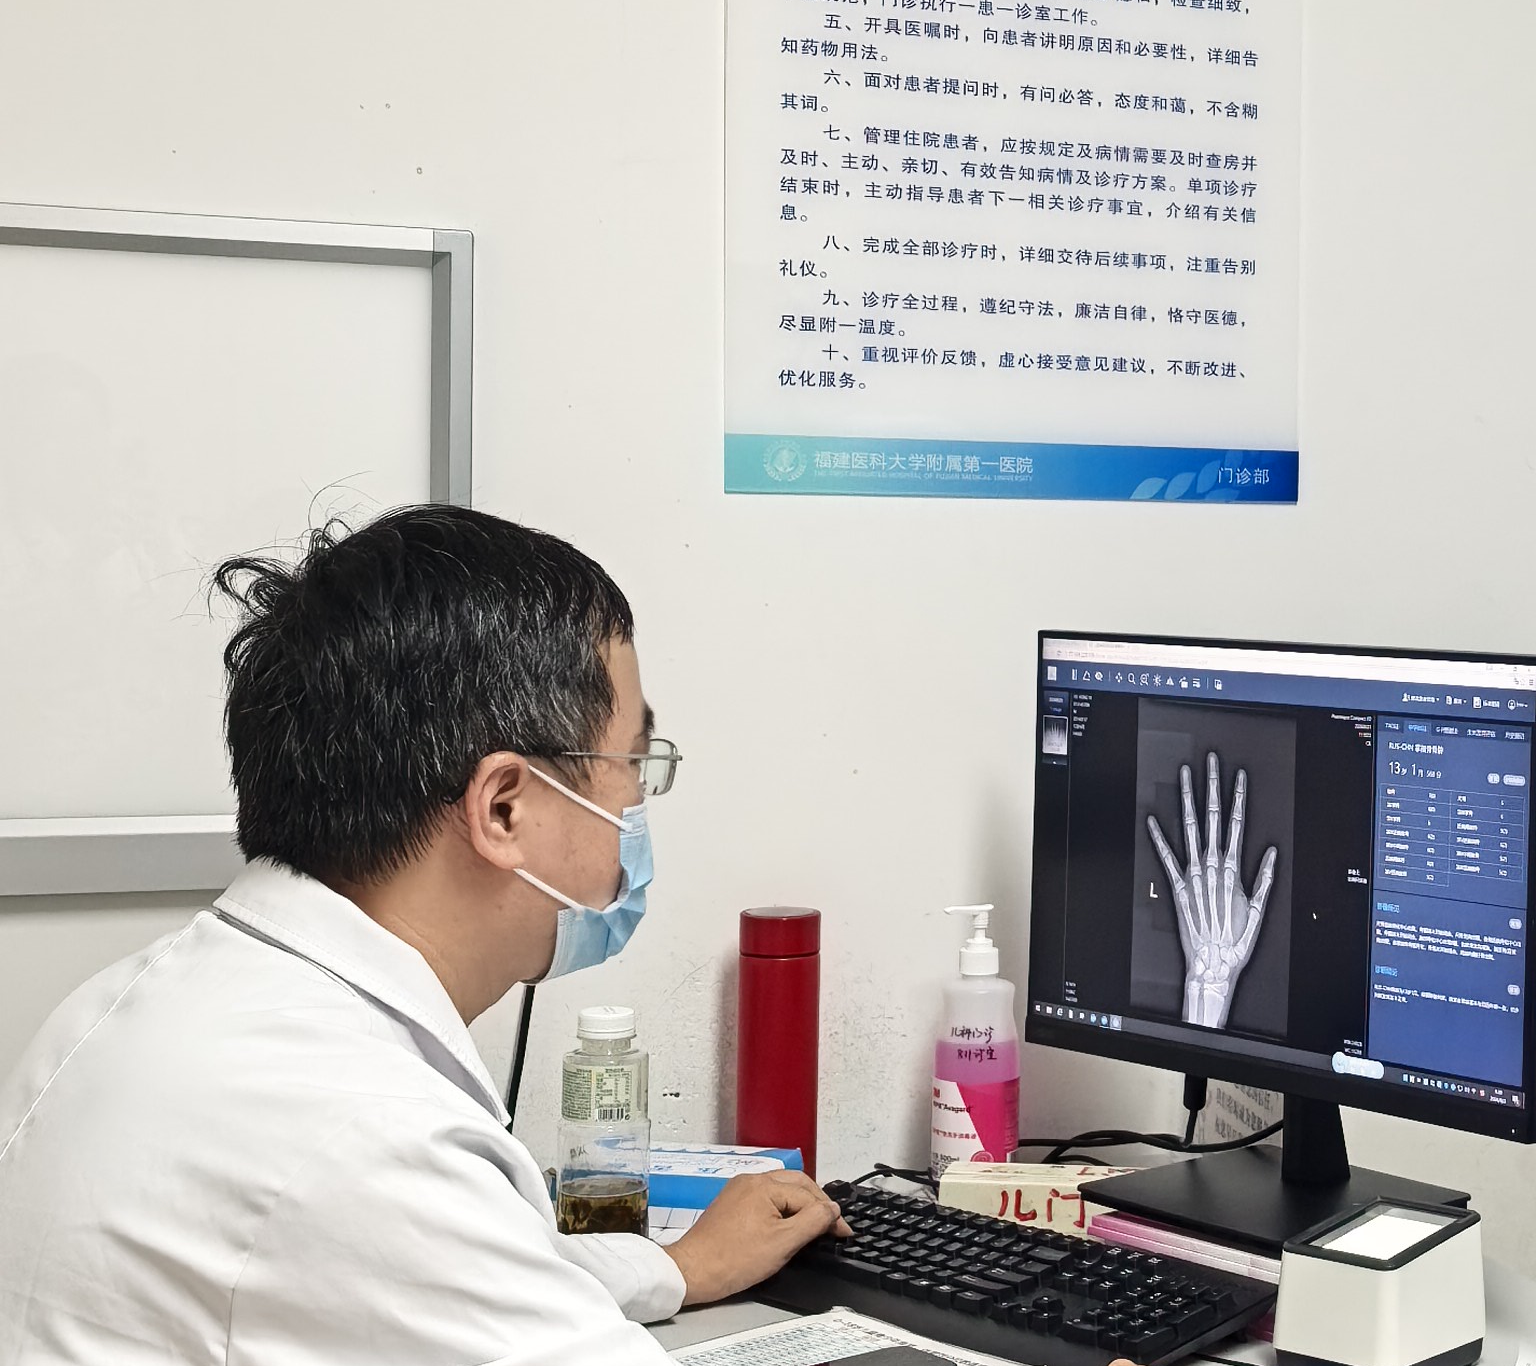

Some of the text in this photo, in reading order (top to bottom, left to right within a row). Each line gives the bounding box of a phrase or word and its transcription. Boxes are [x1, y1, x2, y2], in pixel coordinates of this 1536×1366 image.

[781, 36, 888, 62] 知药物用法。
[780, 92, 829, 113] 其词。
[780, 203, 808, 223] 息。
[778, 259, 828, 279] 礼仪。
[778, 314, 906, 337] 尽显附一温度。
[778, 369, 867, 390] 优化服务。
[814, 450, 1034, 474] 福建医科大学附属第一医院
[1217, 466, 1270, 486] 门诊部
